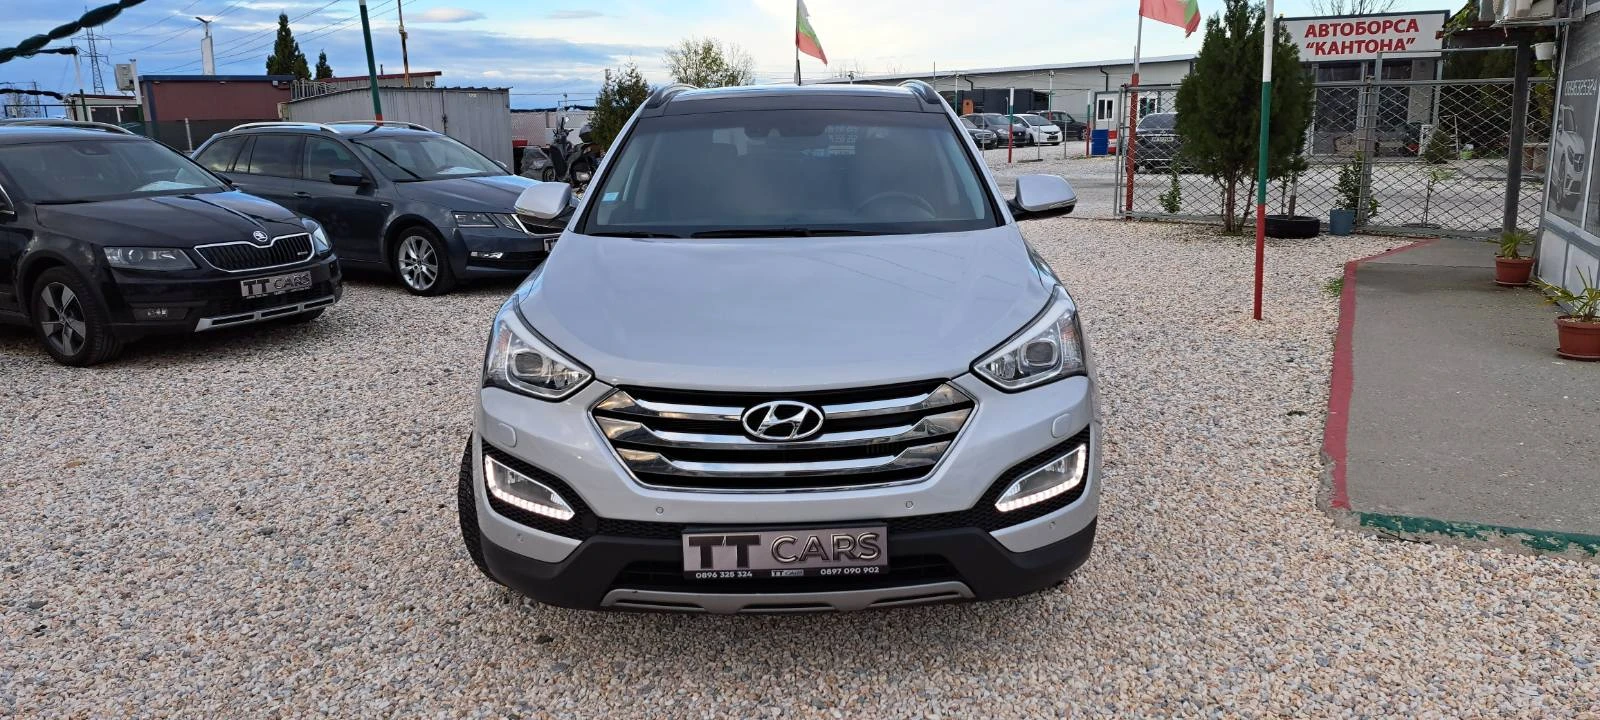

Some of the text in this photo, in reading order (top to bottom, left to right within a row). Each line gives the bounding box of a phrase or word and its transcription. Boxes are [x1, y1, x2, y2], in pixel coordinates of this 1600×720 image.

[1305, 18, 1419, 38] АВТОБОРСА
[243, 279, 270, 295] TT
[274, 272, 310, 289] CARS
[688, 532, 882, 569] TT CARS
